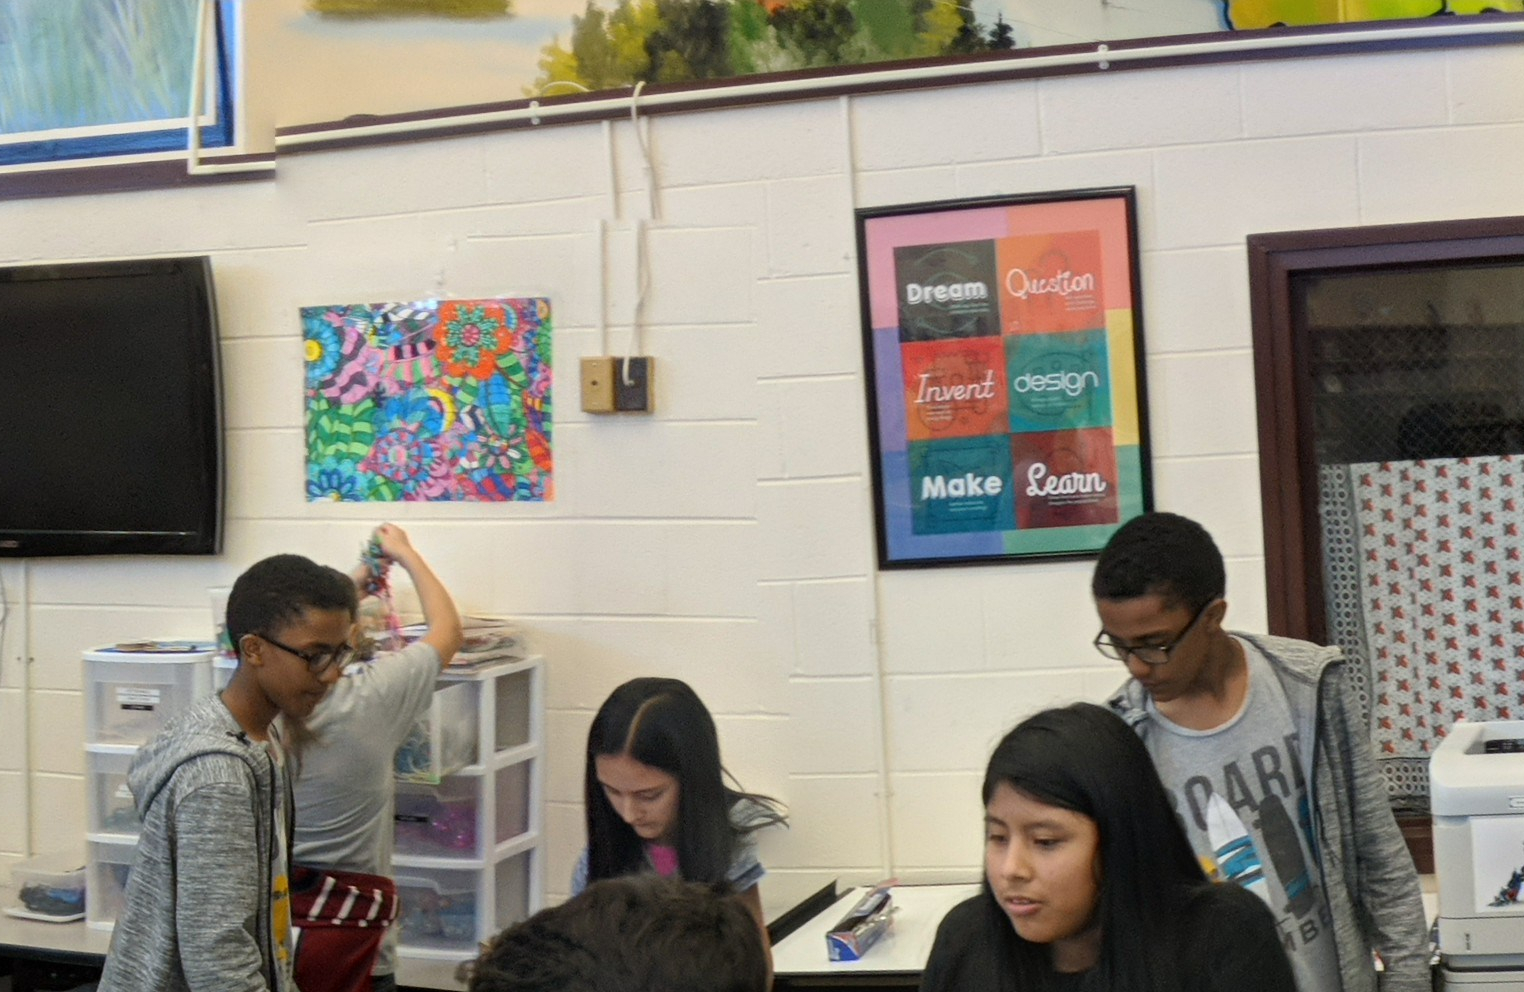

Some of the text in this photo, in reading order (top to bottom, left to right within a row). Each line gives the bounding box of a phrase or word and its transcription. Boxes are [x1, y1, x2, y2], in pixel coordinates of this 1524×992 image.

[906, 279, 988, 305] Dream
[1006, 268, 1095, 300] Question
[914, 370, 995, 404] Invent
[1014, 370, 1101, 397] design
[921, 473, 1003, 500] Make
[1025, 463, 1107, 497] Learn
